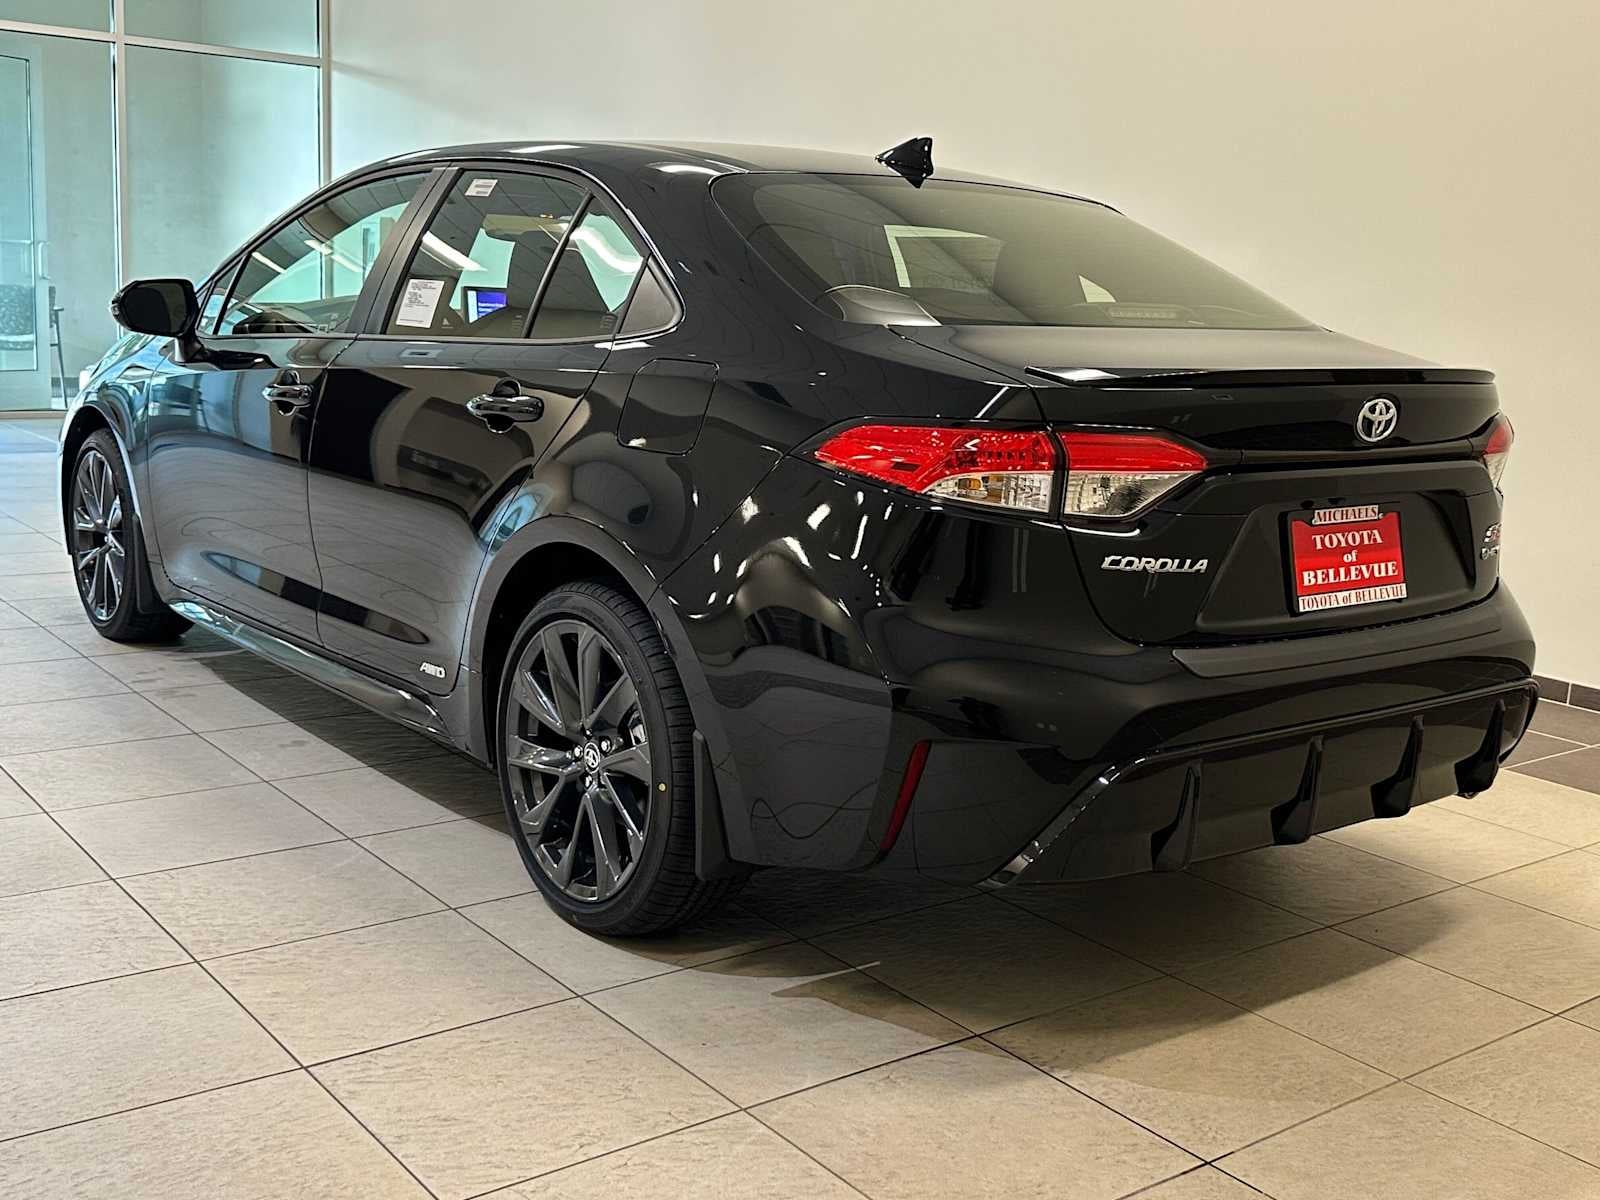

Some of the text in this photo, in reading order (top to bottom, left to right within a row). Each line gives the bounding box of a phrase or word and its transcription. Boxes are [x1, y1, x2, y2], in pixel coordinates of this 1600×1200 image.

[1316, 507, 1377, 521] MICHAELS
[1312, 530, 1382, 549] TOYOTA
[1101, 556, 1208, 573] COROLLA
[1343, 550, 1358, 562] of
[1303, 562, 1398, 586] BELLEVUE
[1300, 584, 1405, 610] TOYOTA of BELLEVUE
